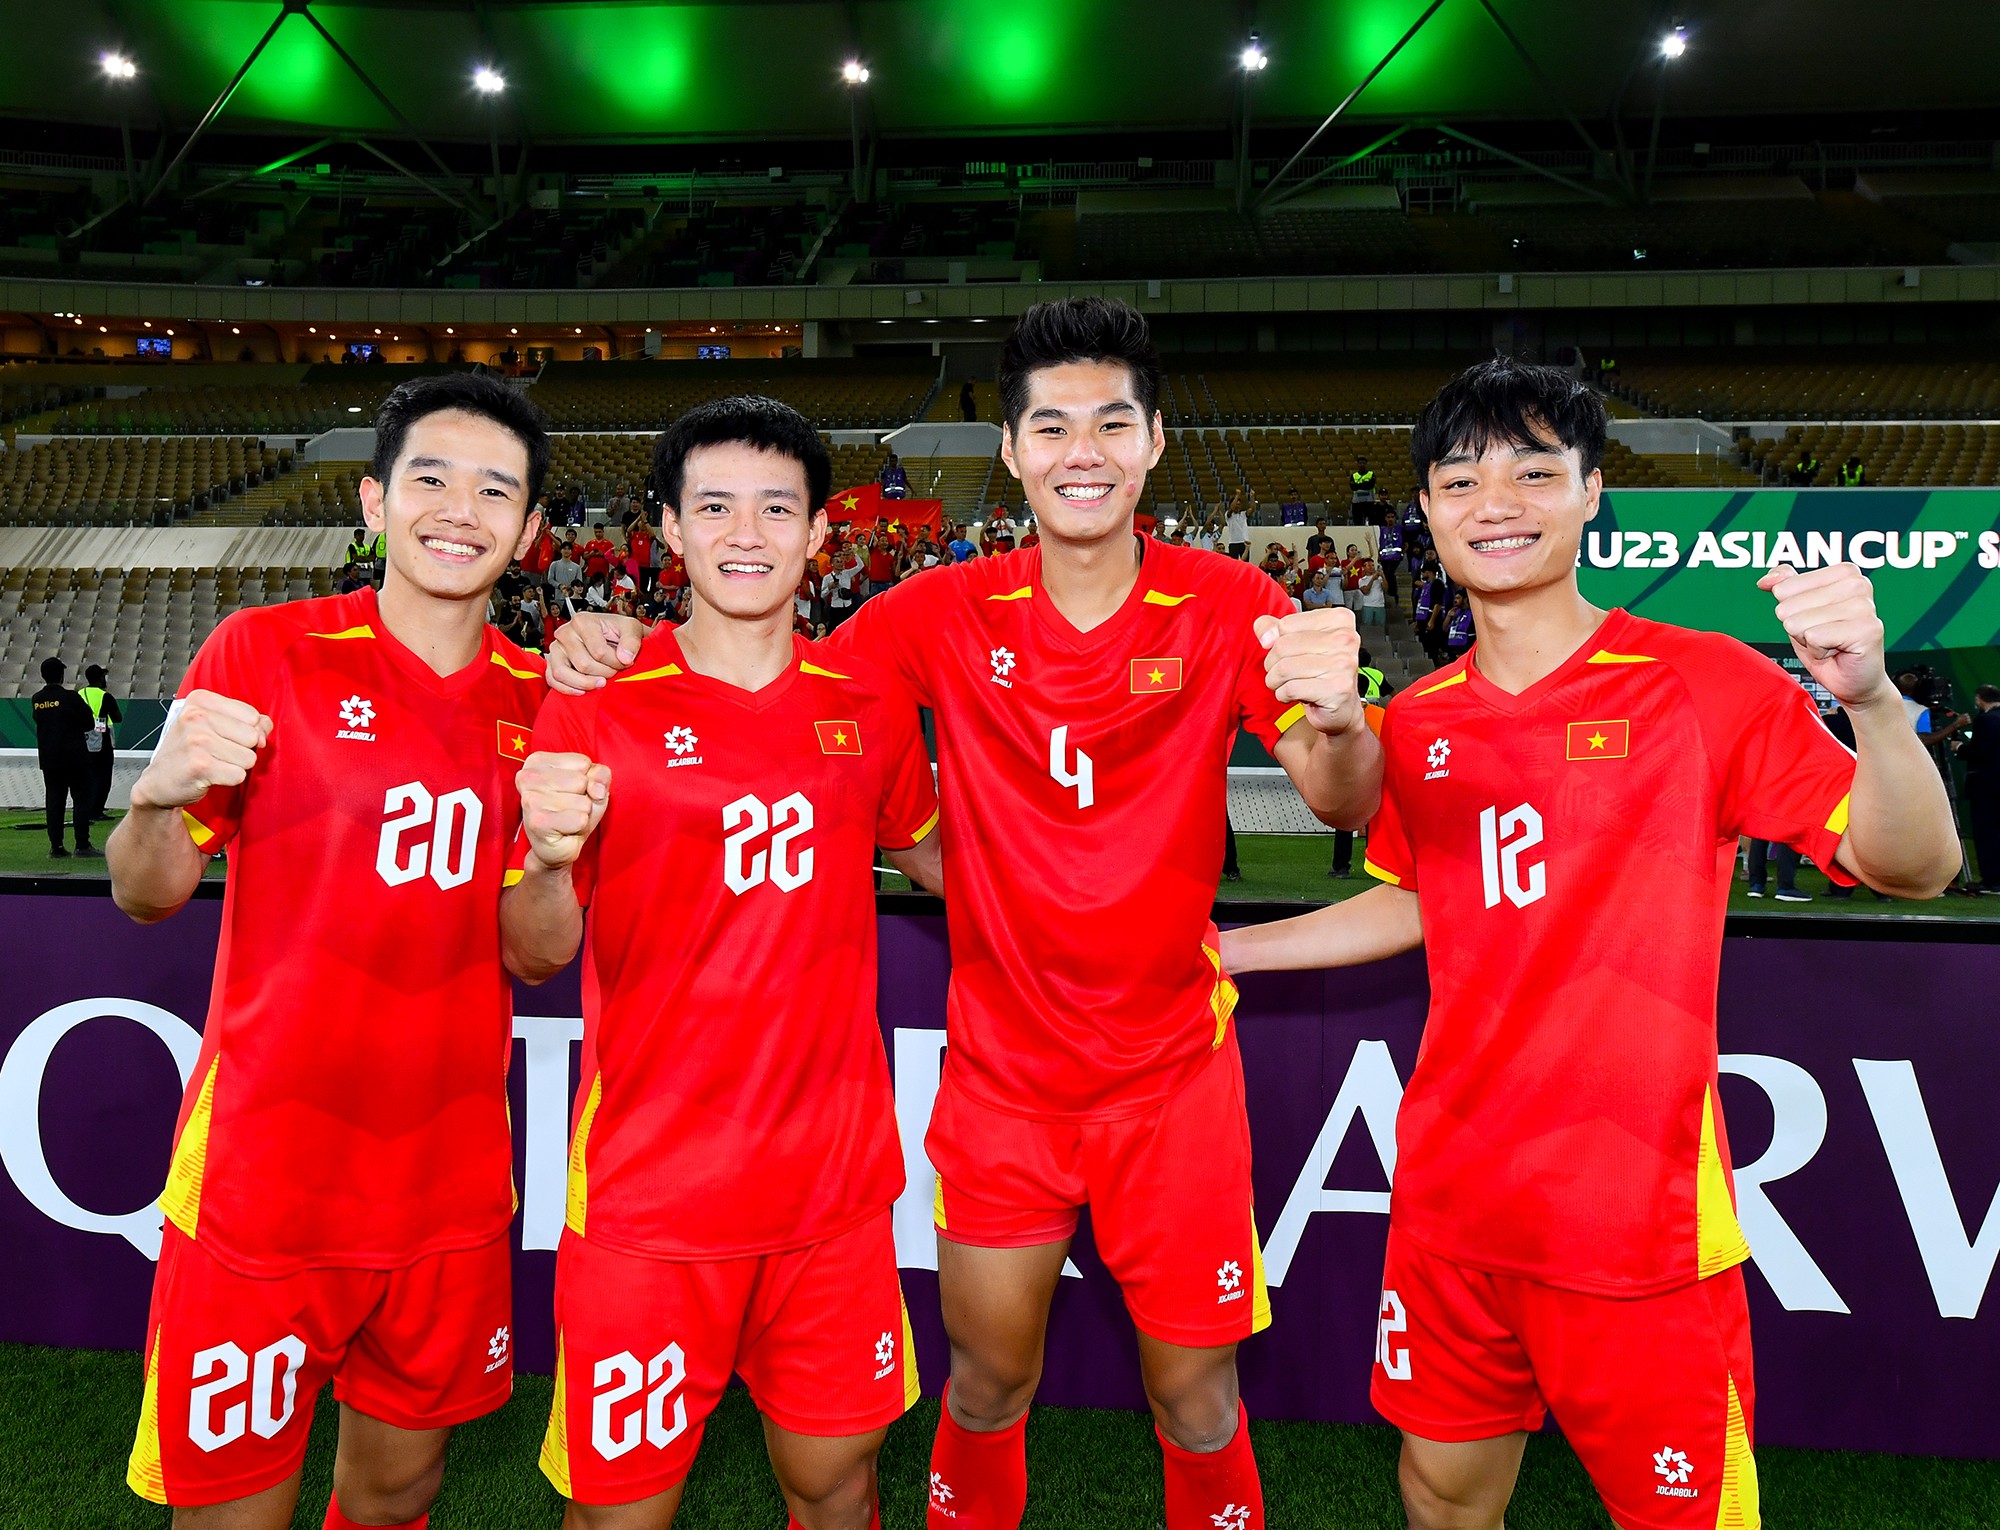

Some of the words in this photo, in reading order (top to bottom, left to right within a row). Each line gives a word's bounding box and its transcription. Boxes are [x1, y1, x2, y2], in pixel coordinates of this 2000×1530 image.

[1588, 531, 1680, 568] U23
[1686, 531, 1842, 568] ASIAN
[1978, 530, 2000, 569] S
[34, 700, 60, 710] Police
[335, 729, 377, 742] JOGARBOLA
[666, 755, 703, 768] JOGARBOLA
[1050, 725, 1094, 809] 4
[376, 781, 483, 891] 20
[722, 791, 814, 896] 22
[1480, 802, 1546, 909] 12
[188, 1334, 306, 1452] 20
[592, 1341, 687, 1461] 22
[1655, 1484, 1698, 1498] JOGARBOLA
